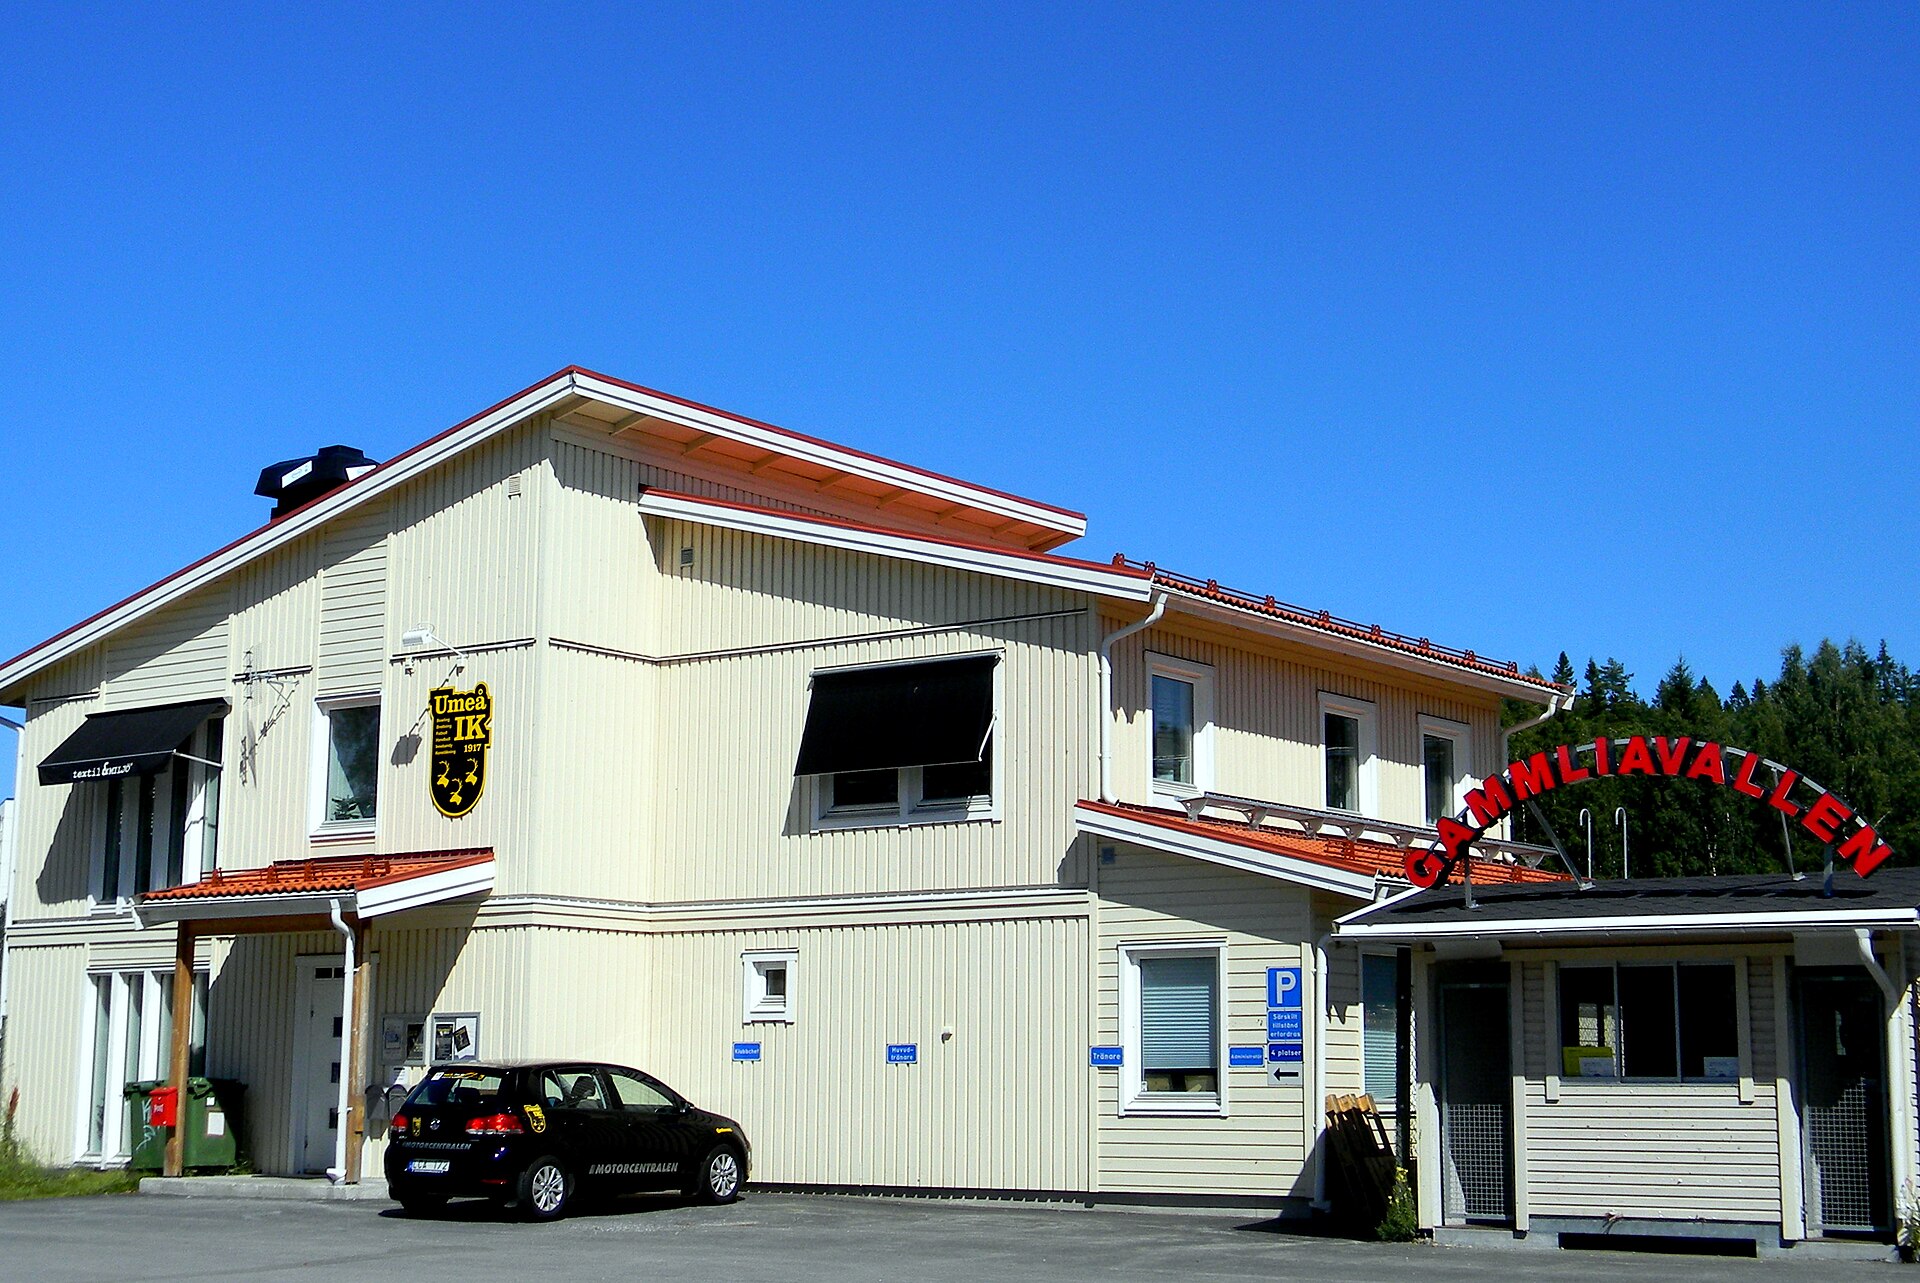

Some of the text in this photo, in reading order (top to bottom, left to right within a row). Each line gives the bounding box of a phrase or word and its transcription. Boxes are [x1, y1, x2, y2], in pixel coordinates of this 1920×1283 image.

[434, 689, 487, 714] Umeå
[454, 714, 486, 741] IK
[463, 743, 482, 753] 1917
[1405, 736, 1894, 889] GAMMLIAVALLEN
[1276, 971, 1297, 1004] P
[1272, 1012, 1298, 1020] Särskilt
[1272, 1021, 1299, 1029] tillstånd
[1093, 1052, 1121, 1060] Tränare
[1277, 1049, 1302, 1057] platser
